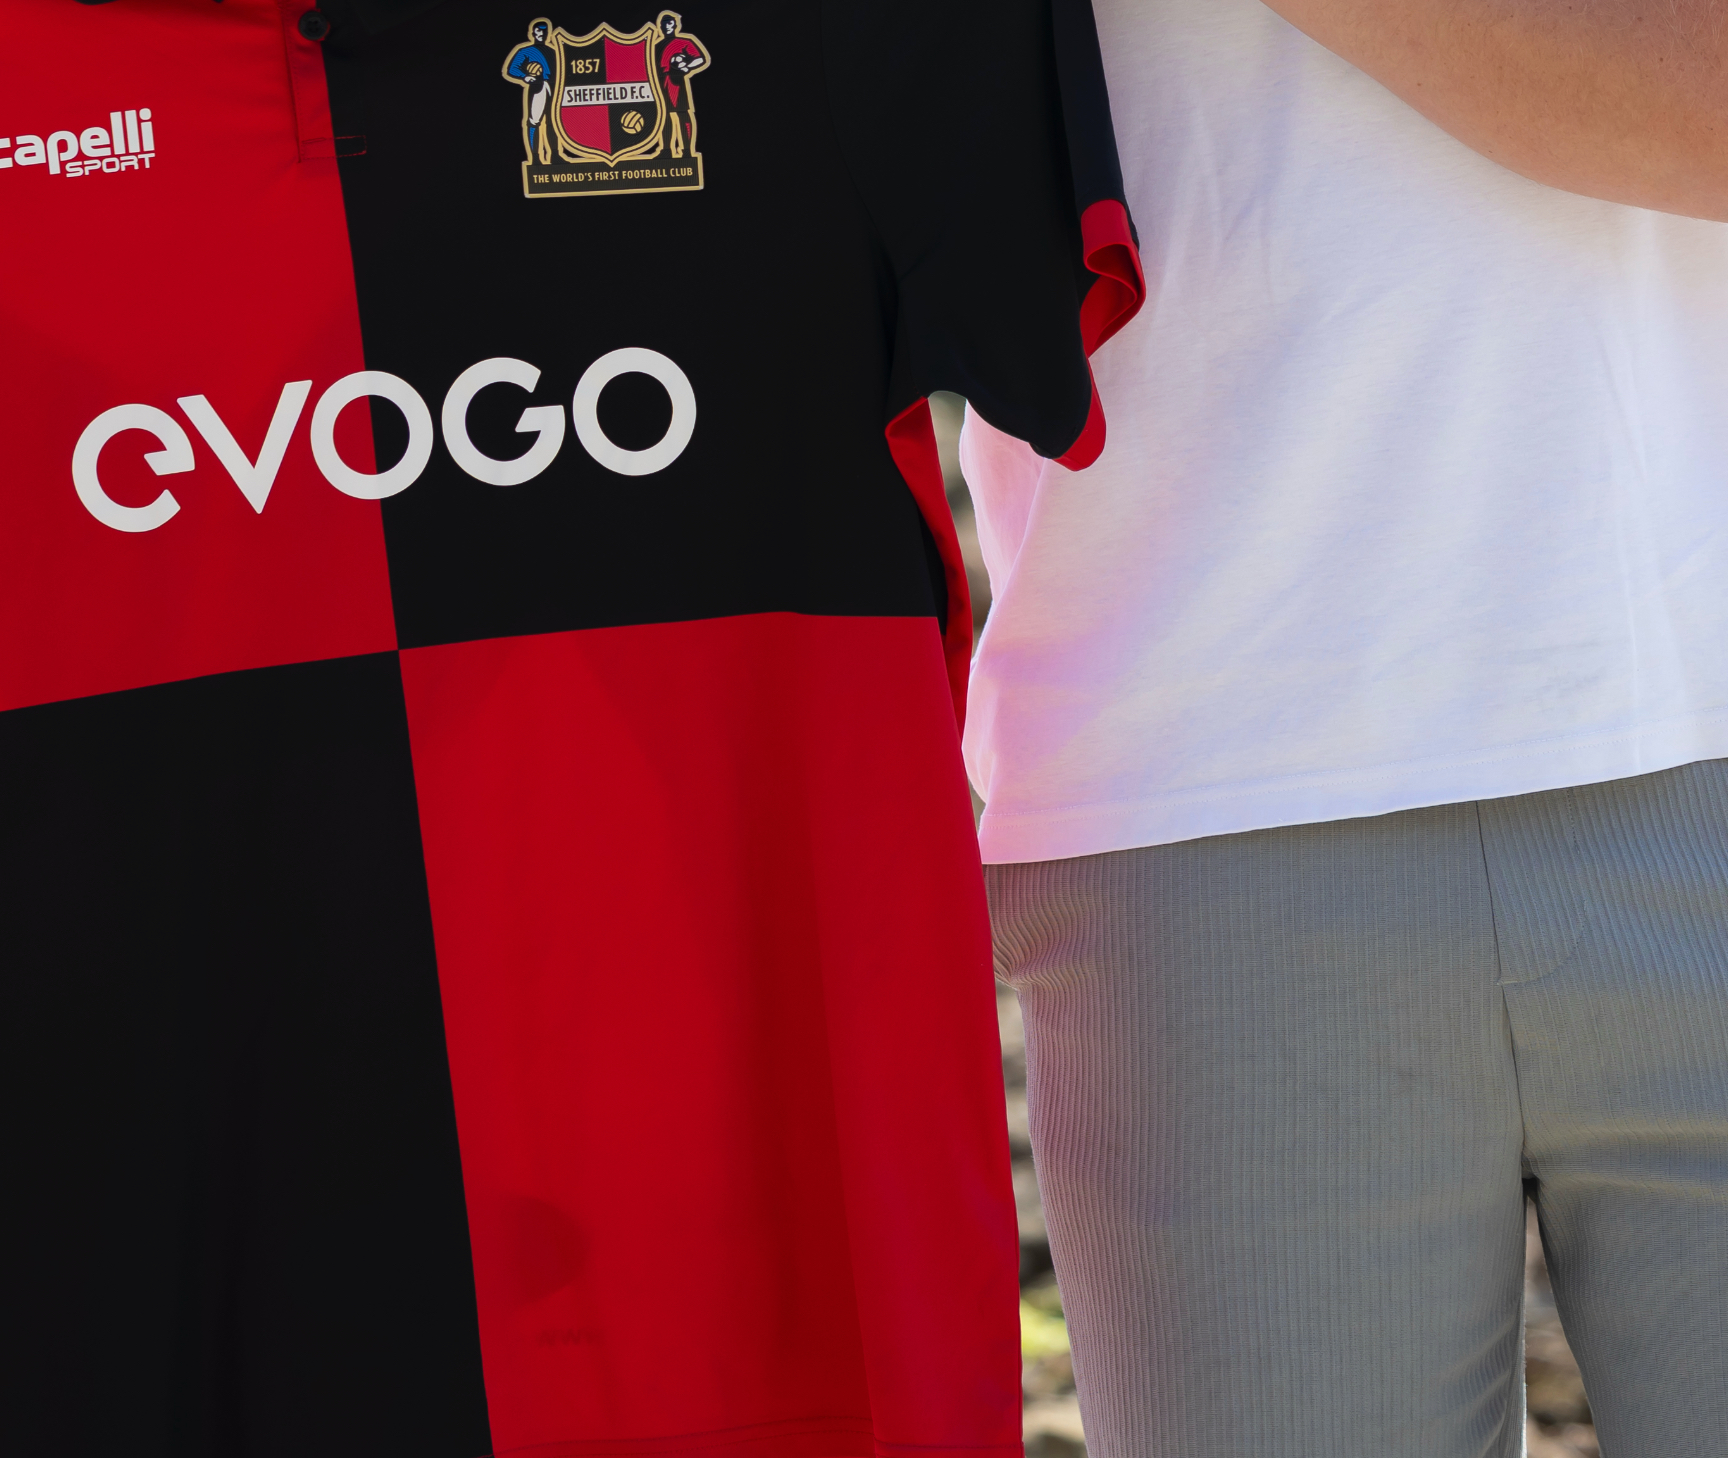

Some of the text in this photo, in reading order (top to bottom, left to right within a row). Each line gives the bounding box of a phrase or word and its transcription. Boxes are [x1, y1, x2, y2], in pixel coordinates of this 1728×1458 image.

[570, 58, 600, 74] 1857
[566, 85, 650, 103] SHEFFIELD F.C.
[65, 152, 156, 178] SPORT
[533, 167, 693, 184] THE WORLD'S FIRST FOOTBALL CLUB
